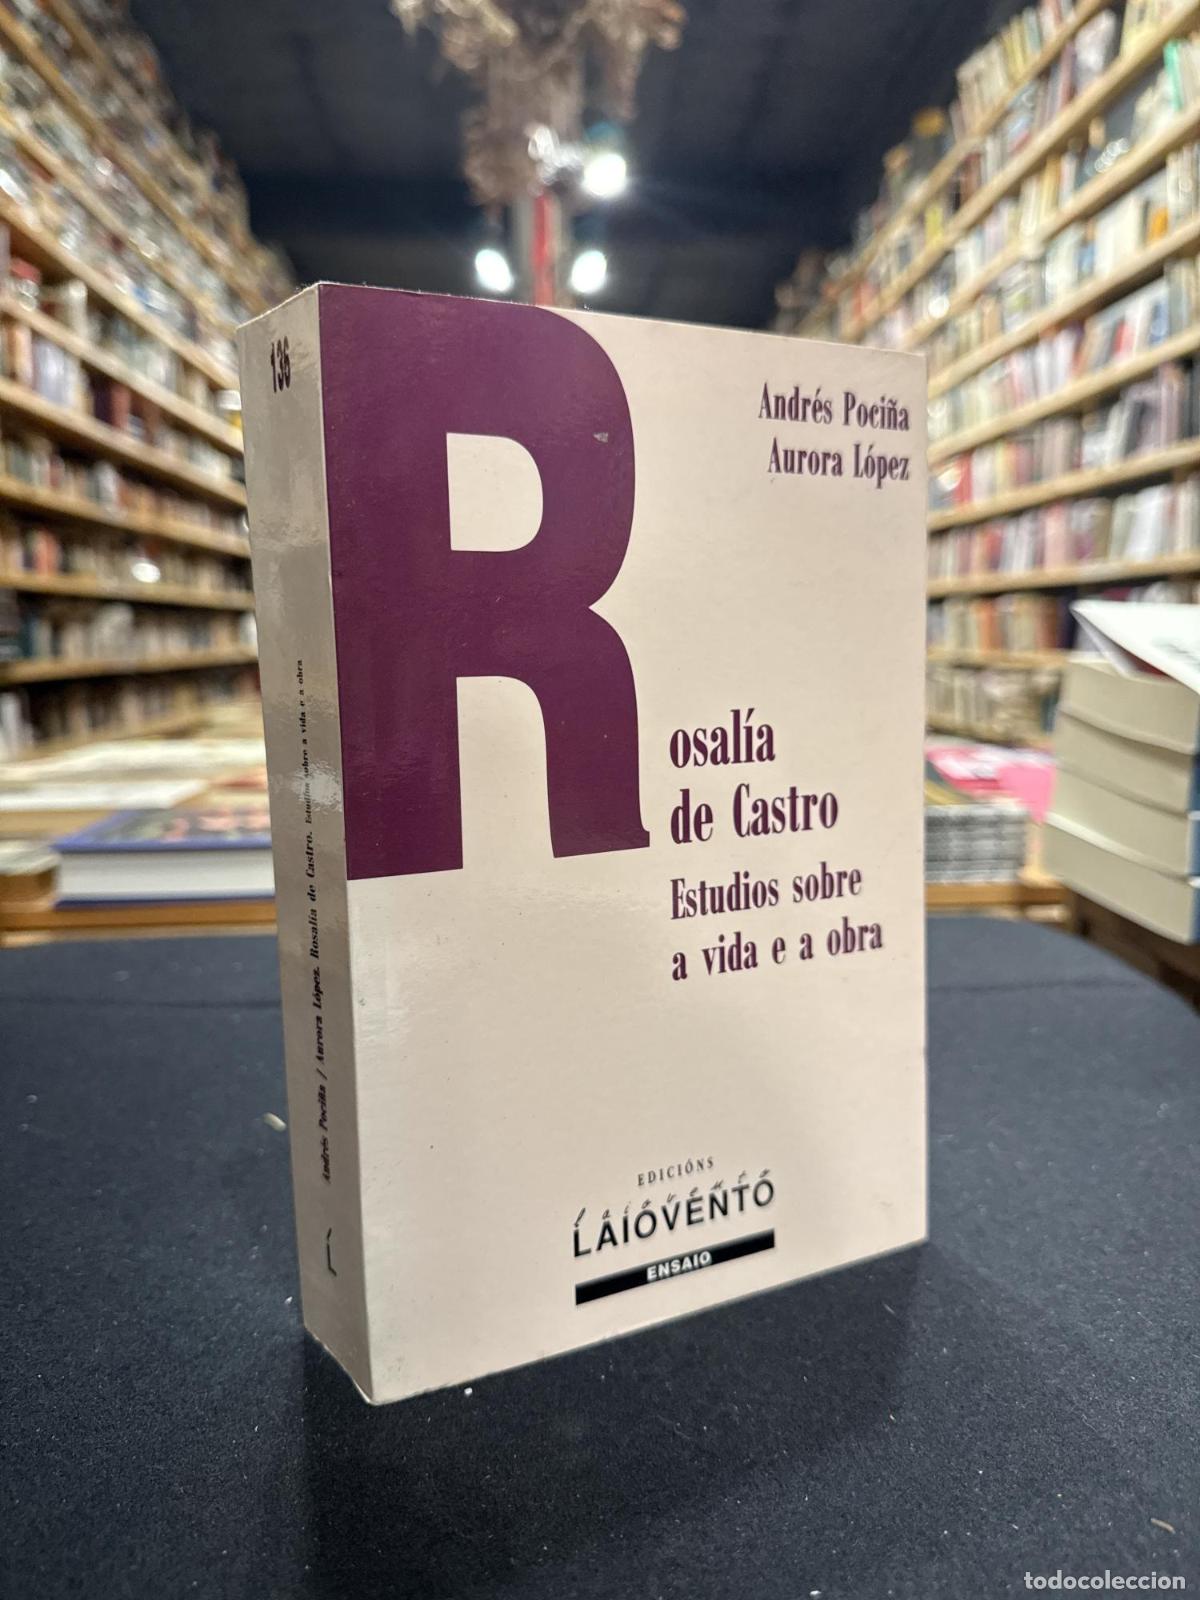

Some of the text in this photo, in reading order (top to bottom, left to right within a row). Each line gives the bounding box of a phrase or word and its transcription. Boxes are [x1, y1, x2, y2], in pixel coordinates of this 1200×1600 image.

[270, 335, 291, 393] 136
[758, 381, 910, 431] Andrés Pociña
[767, 437, 910, 489] Aurora López
[319, 283, 650, 880] R
[296, 659, 304, 685] obra
[299, 711, 307, 734] vida
[669, 708, 776, 768] osalía
[670, 783, 839, 844] de Castro
[305, 831, 316, 878] Castro.
[307, 885, 317, 902] de
[670, 861, 862, 920] Estudios sobre
[308, 909, 320, 959] Rosalía
[672, 916, 884, 981] a vida e a obra
[312, 966, 324, 1010] López.
[315, 1016, 325, 1066] Aurora
[318, 1084, 328, 1131] Pociña
[320, 1135, 331, 1184] Andrés
[637, 1156, 715, 1186] EDICIÓNS
[646, 1250, 712, 1282] ENSAIO
